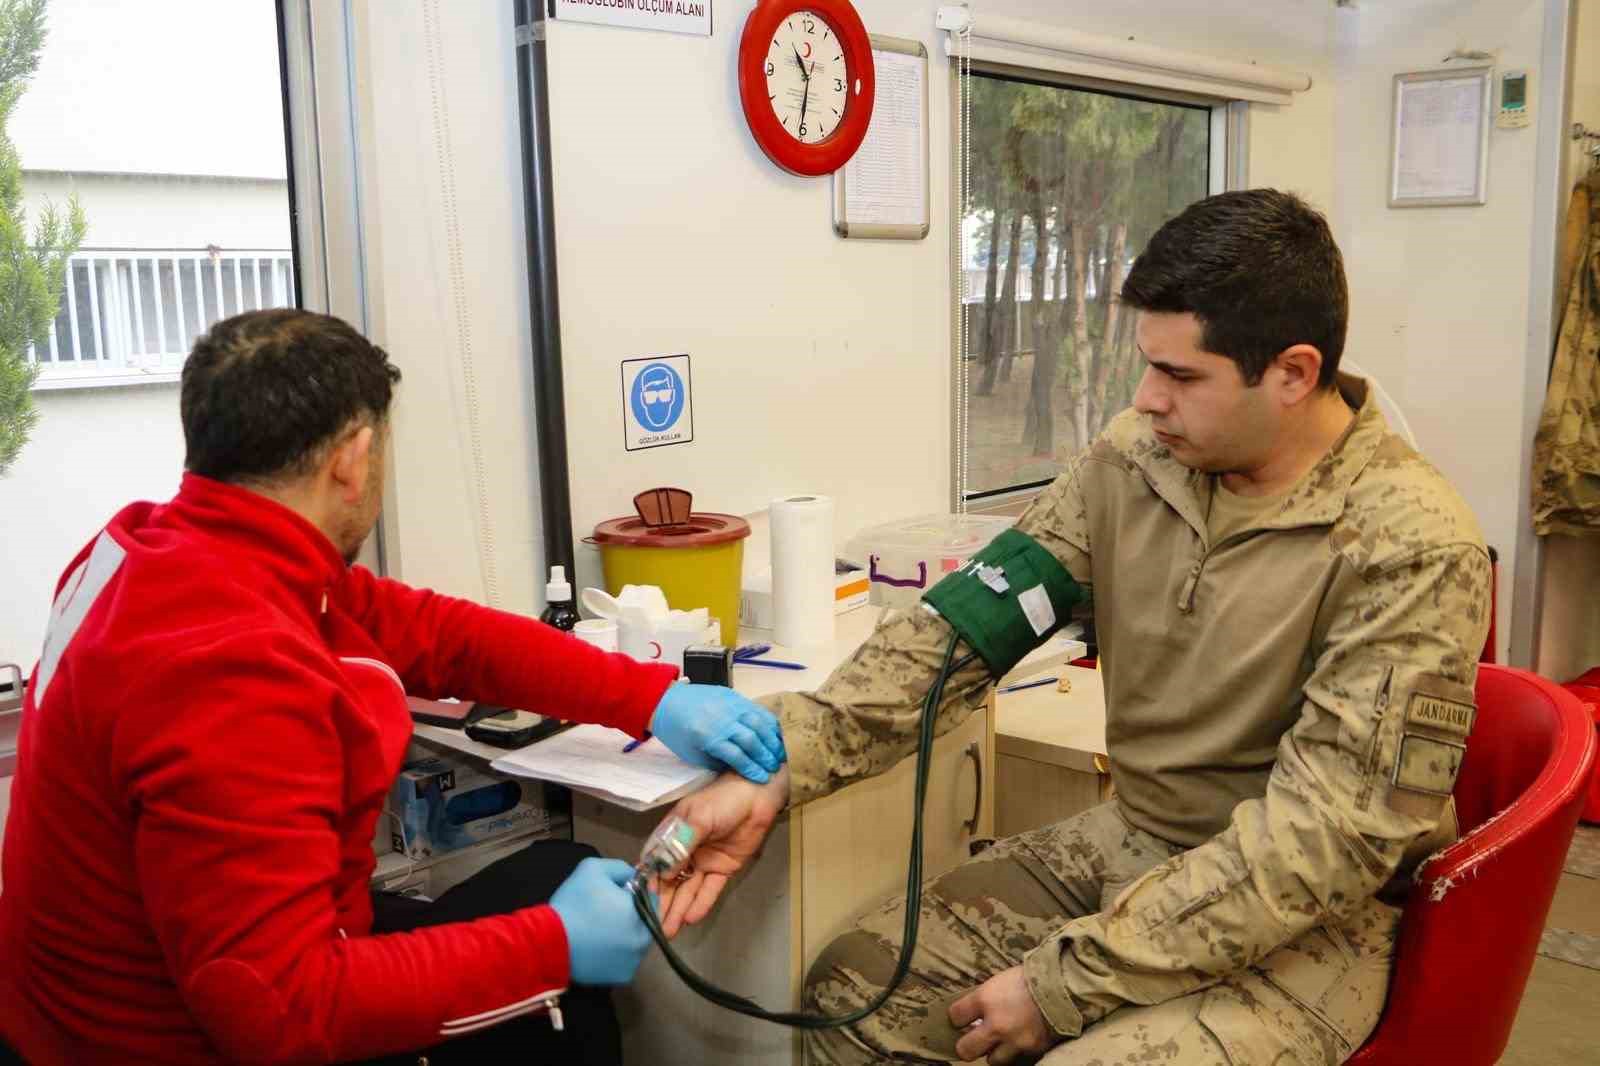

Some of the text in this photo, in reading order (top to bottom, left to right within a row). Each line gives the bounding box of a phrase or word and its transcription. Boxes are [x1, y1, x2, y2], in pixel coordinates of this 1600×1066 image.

[676, 1, 705, 17] ALANI
[802, 20, 815, 34] 12
[767, 62, 775, 76] 9
[834, 78, 843, 92] 3
[799, 122, 807, 136] 6
[1416, 701, 1468, 728] JANDARMA
